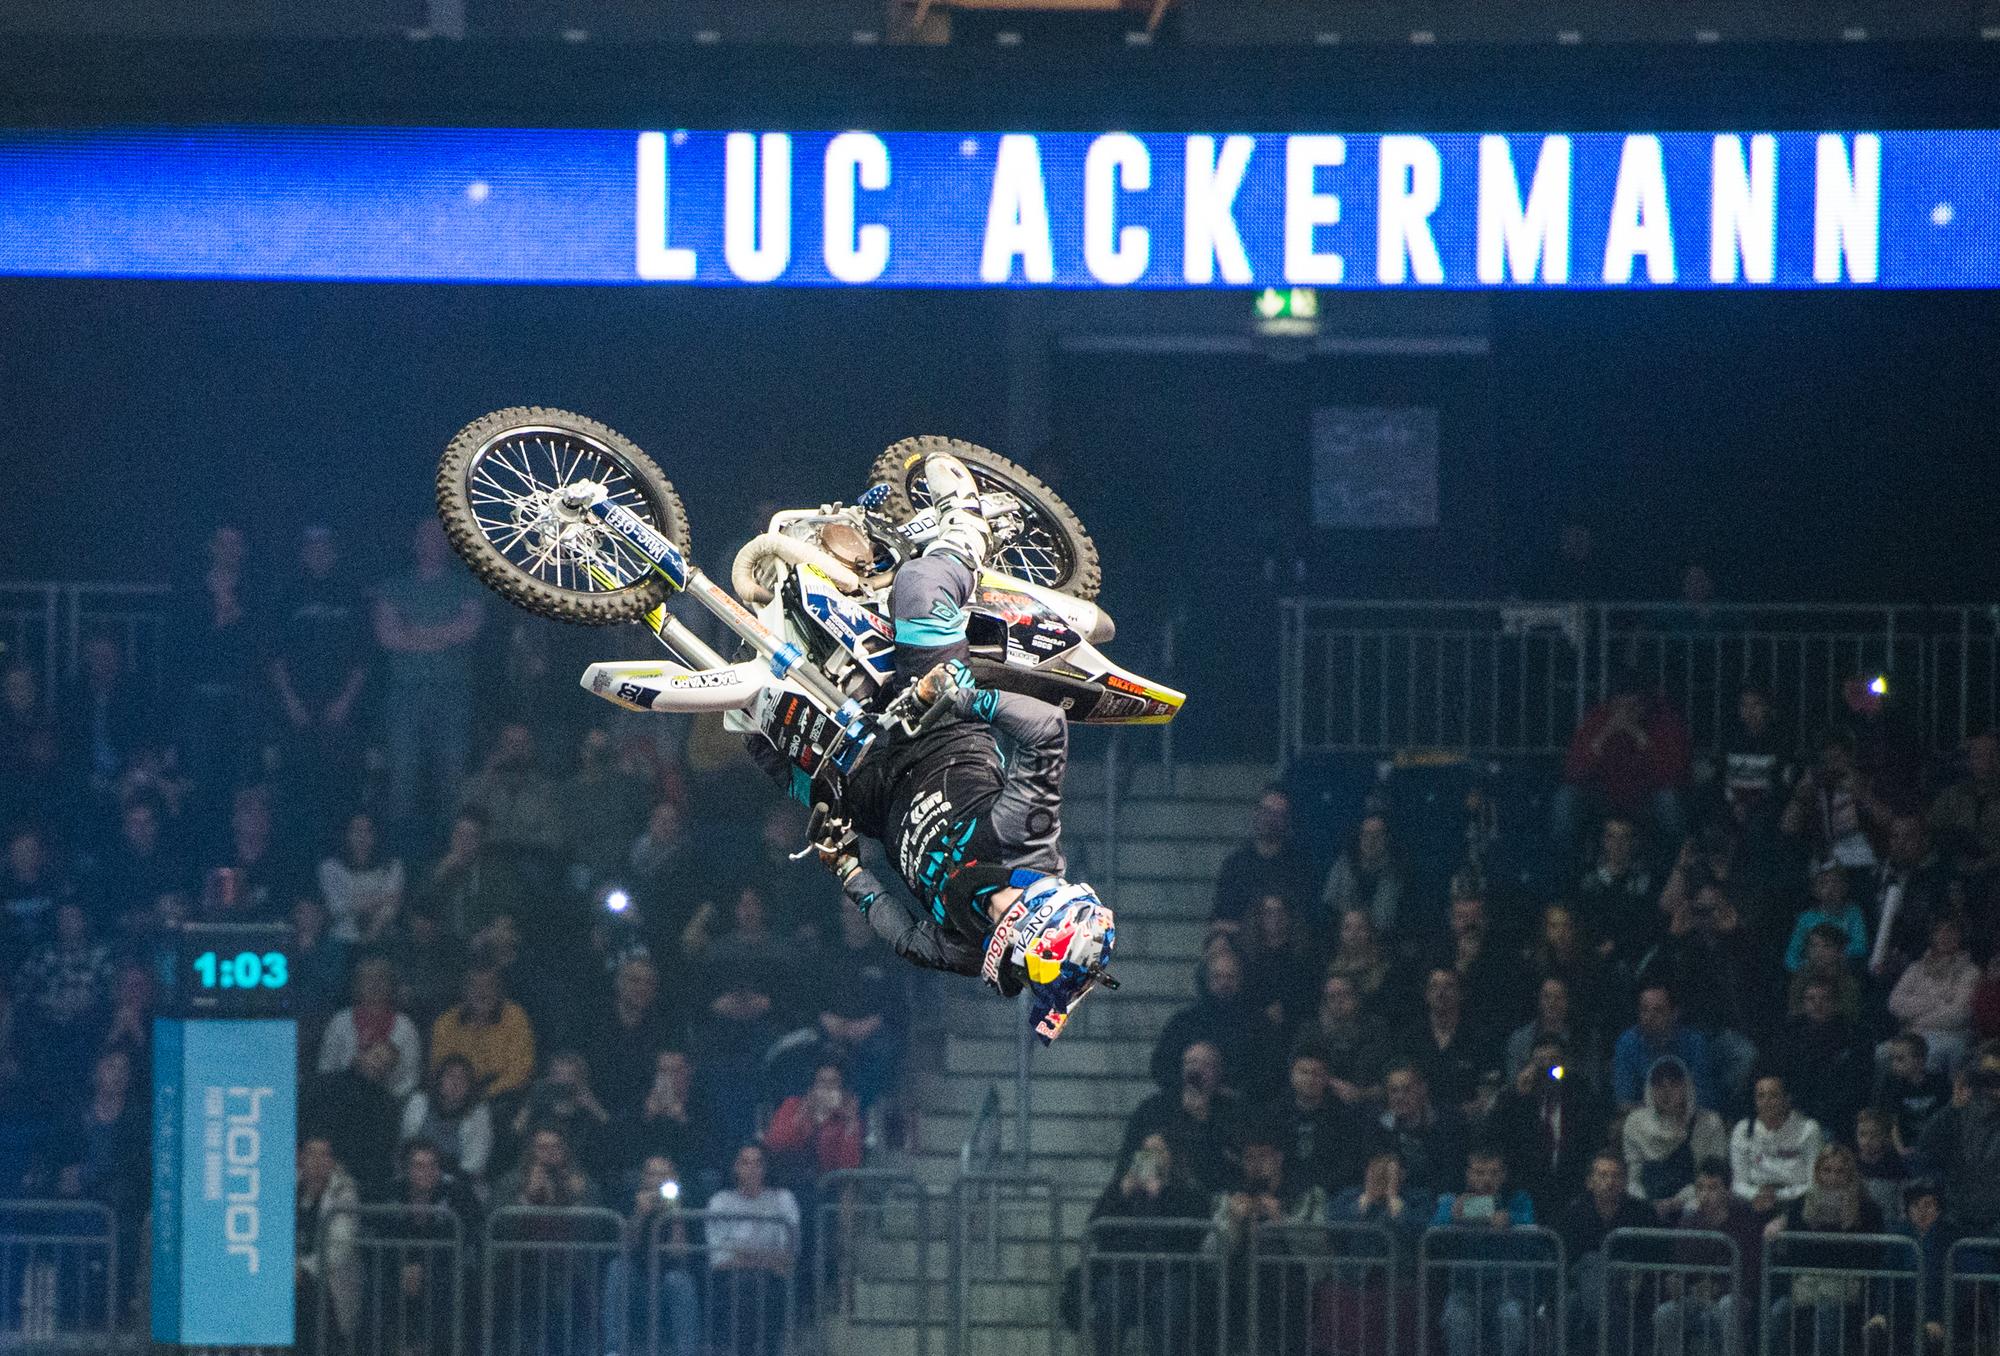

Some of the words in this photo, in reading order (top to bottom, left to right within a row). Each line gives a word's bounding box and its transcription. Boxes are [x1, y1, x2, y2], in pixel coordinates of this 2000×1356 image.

[636, 131, 891, 282] LUC
[979, 131, 1882, 284] ACKERMANN
[670, 670, 743, 689] BACKYARD
[1107, 676, 1145, 695] MAXXIS
[193, 952, 288, 990] 1:03
[224, 1086, 273, 1274] honor
